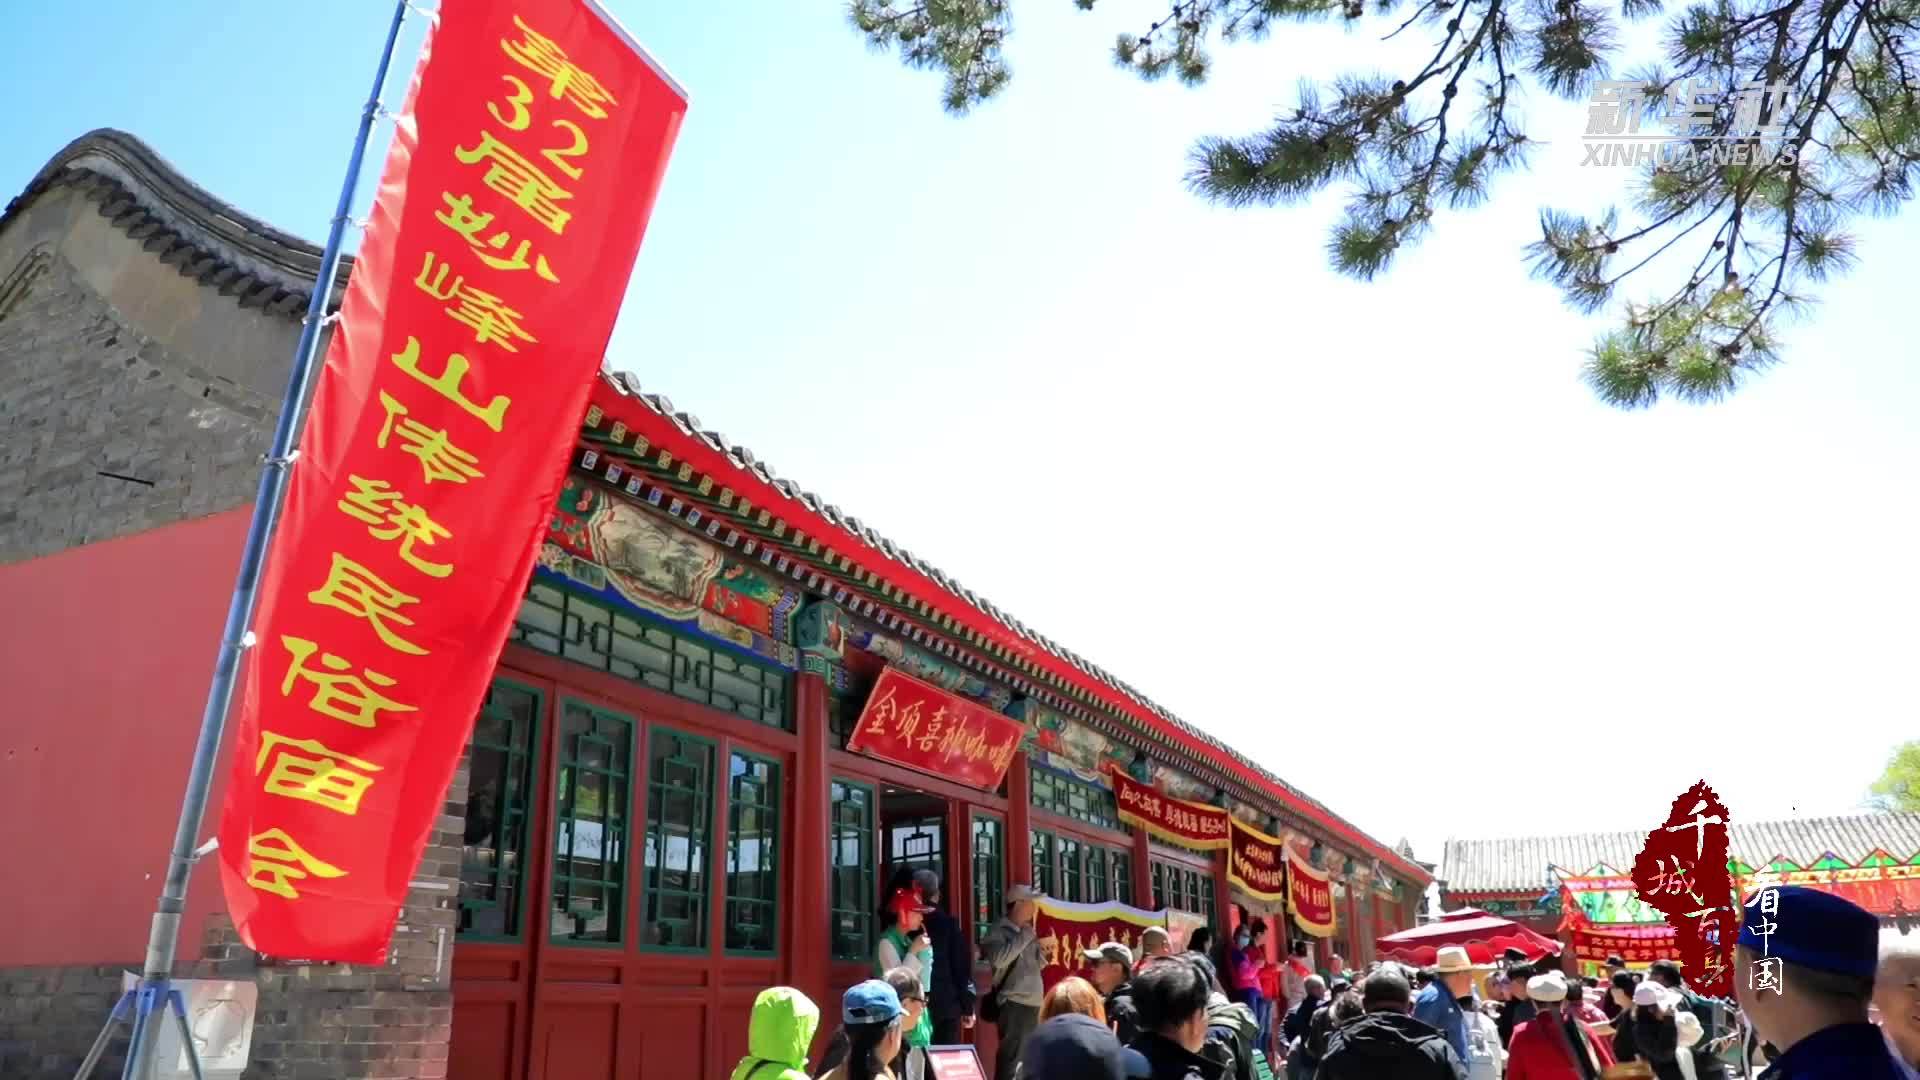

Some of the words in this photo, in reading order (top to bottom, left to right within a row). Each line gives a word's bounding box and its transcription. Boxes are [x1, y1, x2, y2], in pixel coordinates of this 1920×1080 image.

[246, 14, 618, 899] 第32届妙峰山传统民俗庙会
